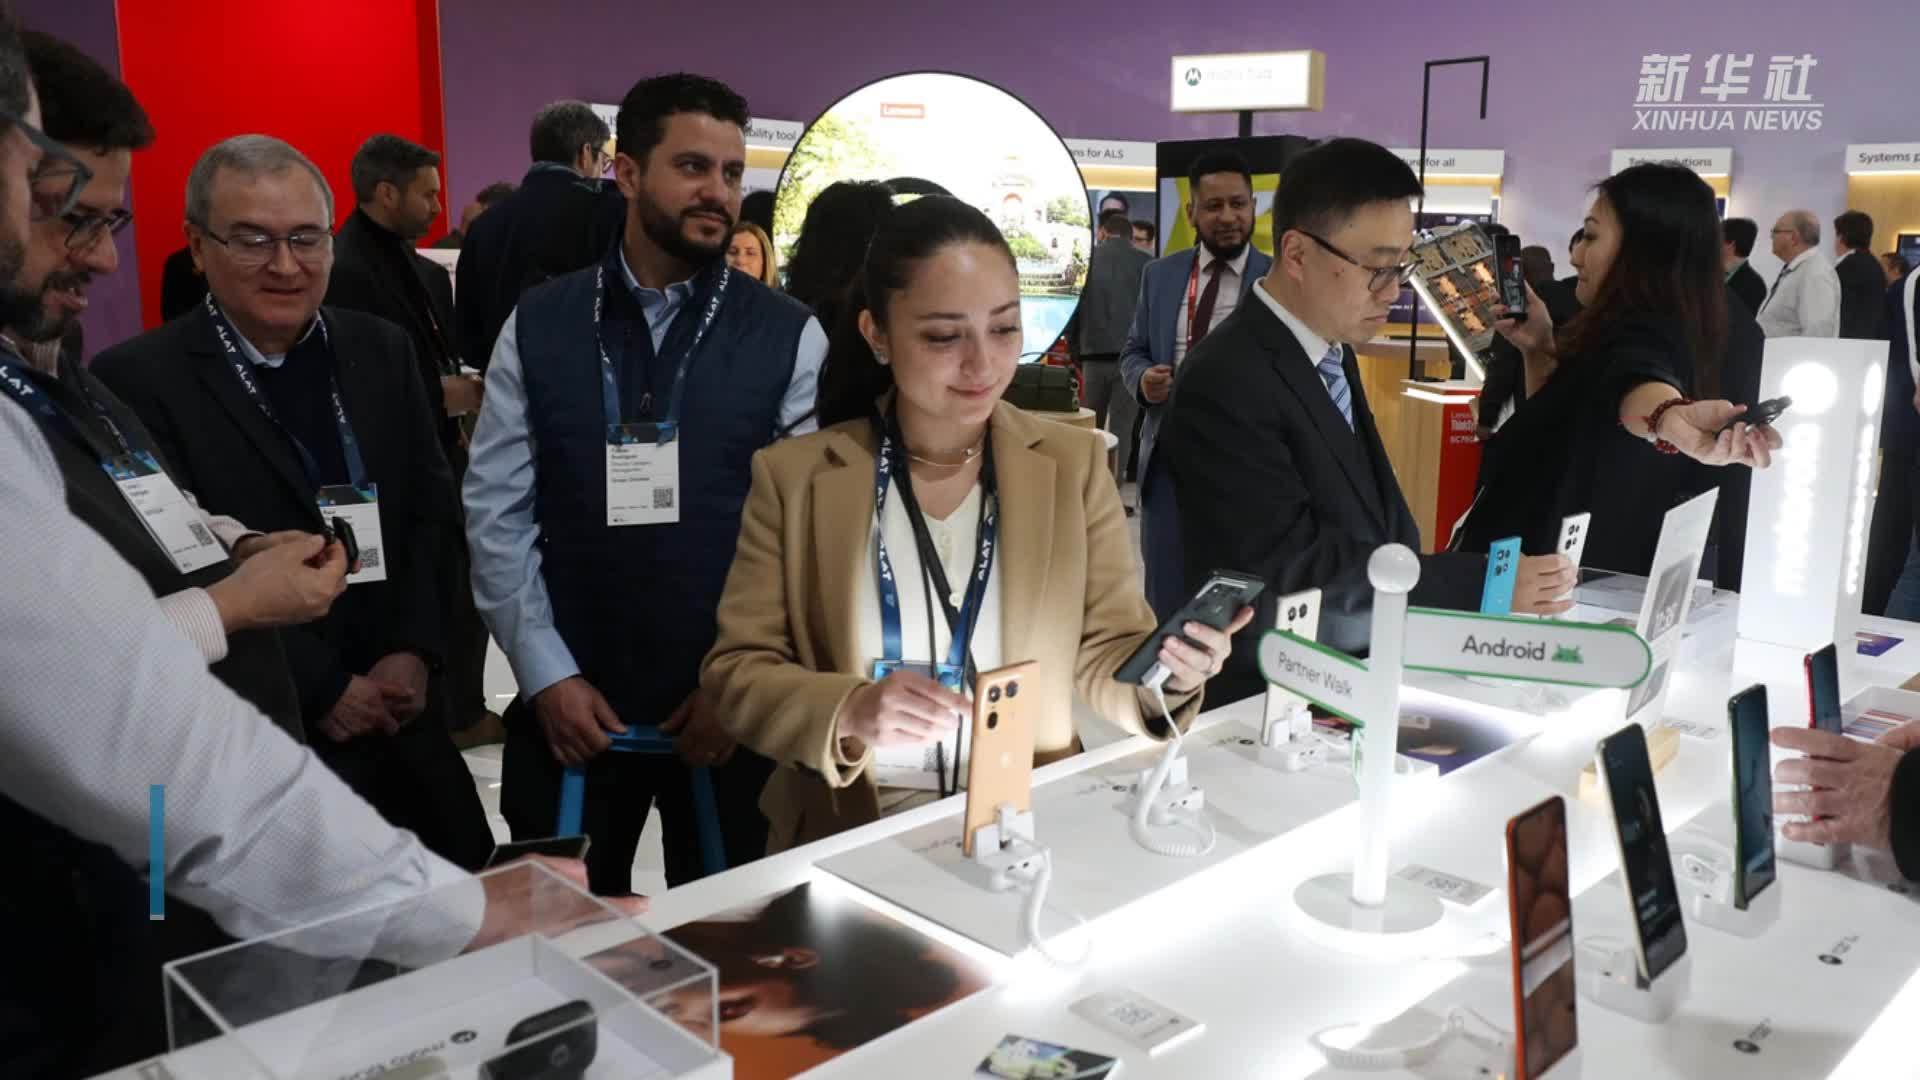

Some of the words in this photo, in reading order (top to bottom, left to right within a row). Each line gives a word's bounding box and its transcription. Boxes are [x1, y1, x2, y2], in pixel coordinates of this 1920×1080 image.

[776, 129, 797, 141] tool
[1087, 147, 1101, 158] for
[1103, 148, 1124, 159] ALS
[1425, 157, 1441, 168] for
[1442, 157, 1456, 168] all
[1858, 152, 1911, 165] Systems
[216, 324, 236, 353] ALAT
[0, 365, 35, 396] LAT
[235, 364, 257, 393] ALAT
[977, 539, 992, 581] ALAT
[1462, 634, 1546, 661] Android
[1278, 650, 1321, 683] Partner
[1323, 671, 1354, 699] Walk
